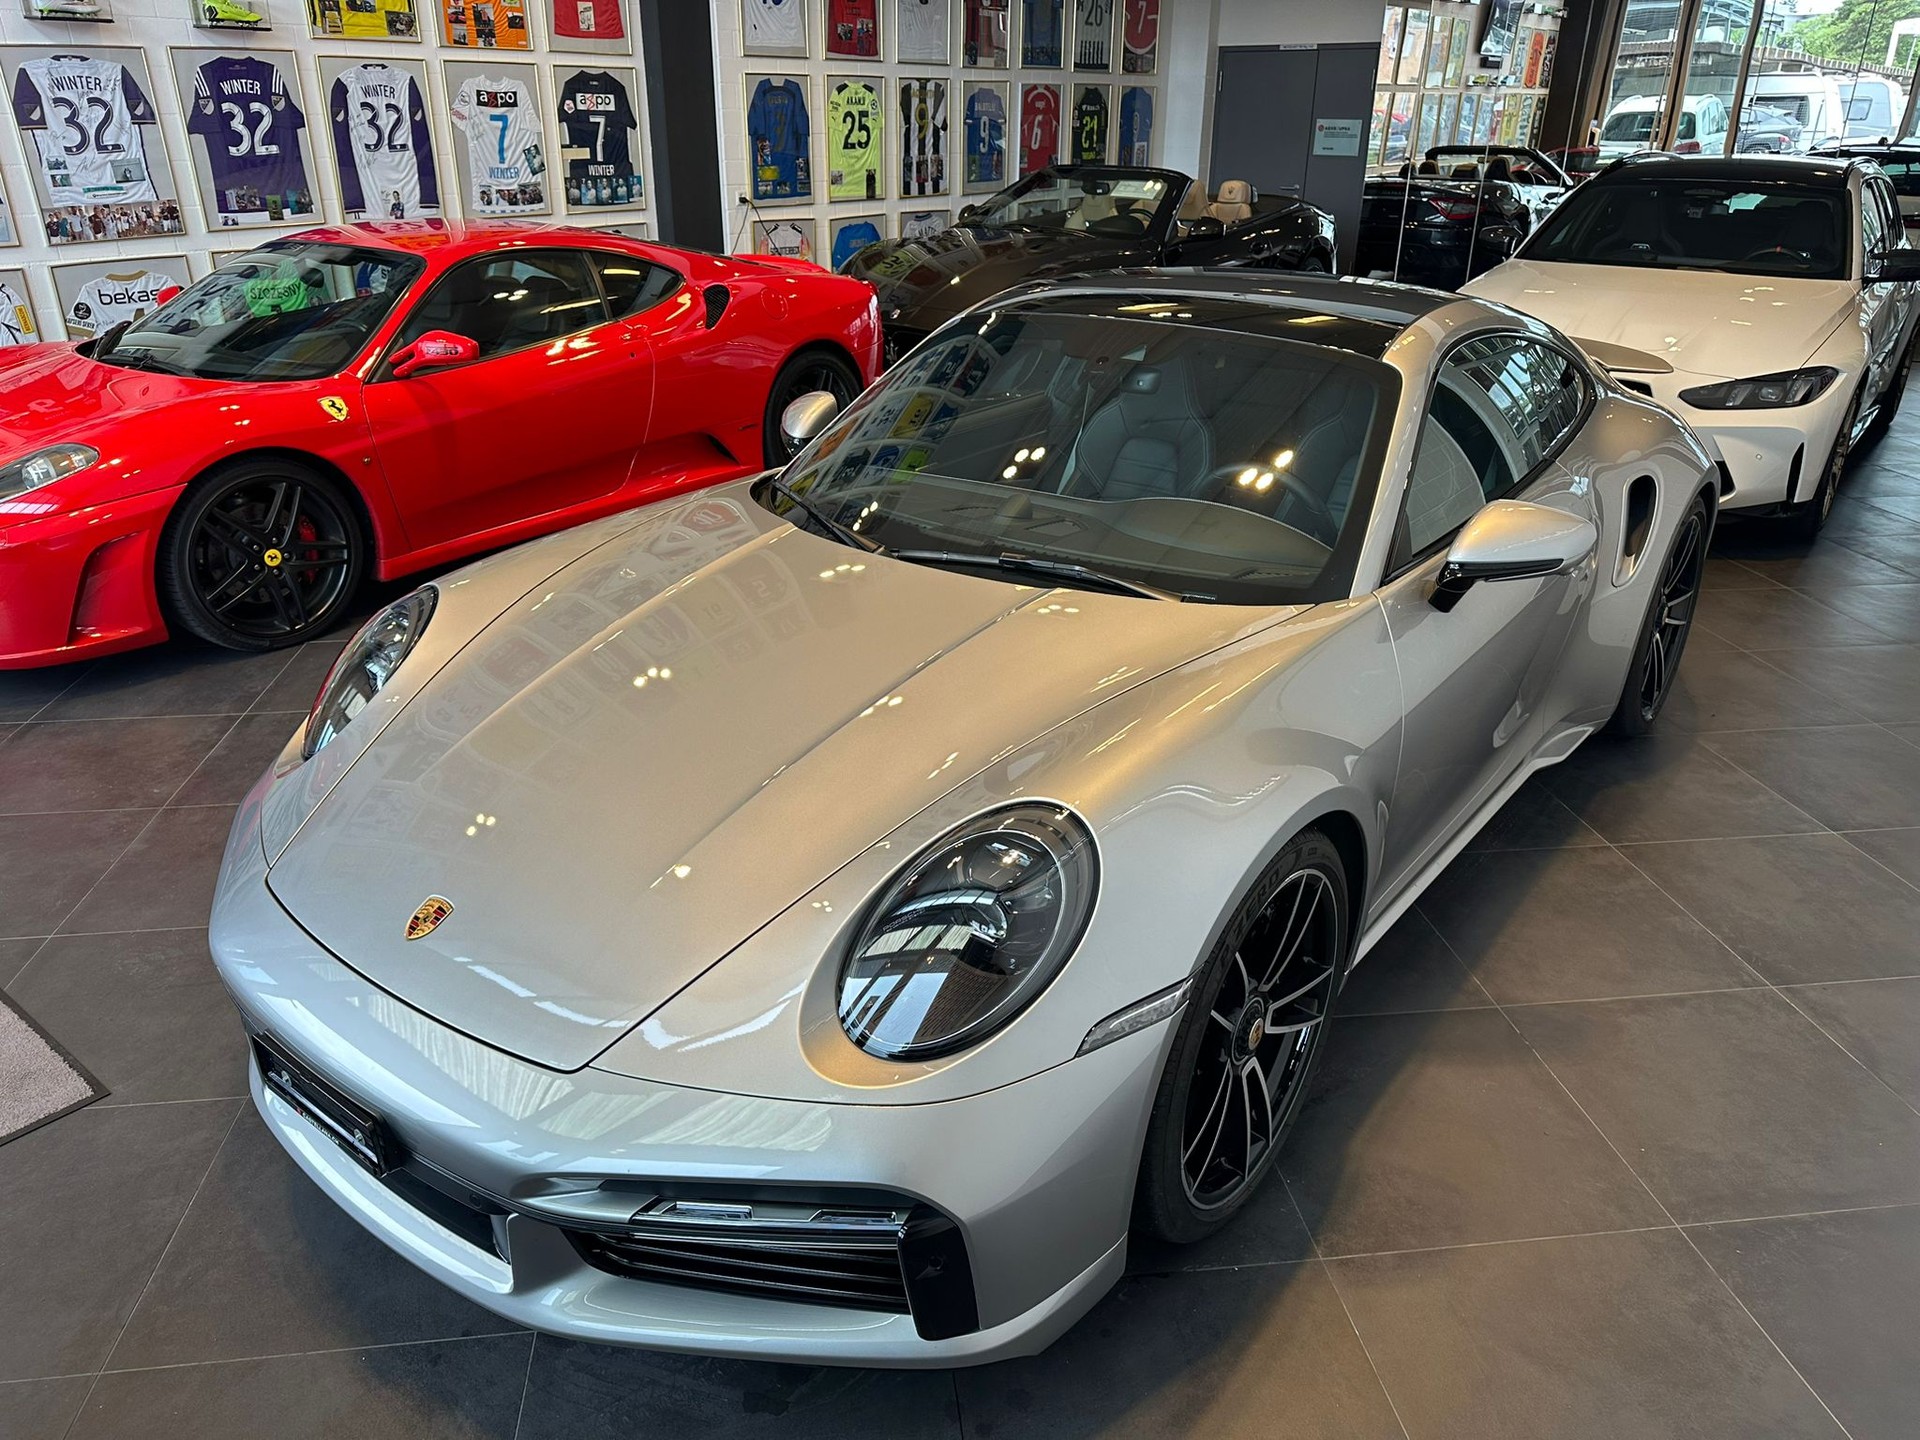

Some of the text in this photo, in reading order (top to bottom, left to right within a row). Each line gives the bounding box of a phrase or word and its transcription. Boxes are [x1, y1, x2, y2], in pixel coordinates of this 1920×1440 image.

[51, 75, 103, 92] WINTER
[219, 79, 261, 95] WINTER
[360, 84, 396, 99] WINTER
[52, 96, 126, 156] 32
[221, 101, 281, 156] 32
[359, 101, 410, 153] 32
[489, 114, 509, 165] 7
[589, 115, 606, 162] 7
[842, 110, 871, 150] 25
[980, 115, 990, 153] 9
[488, 166, 520, 180] WINTER
[587, 164, 615, 176] WINTER
